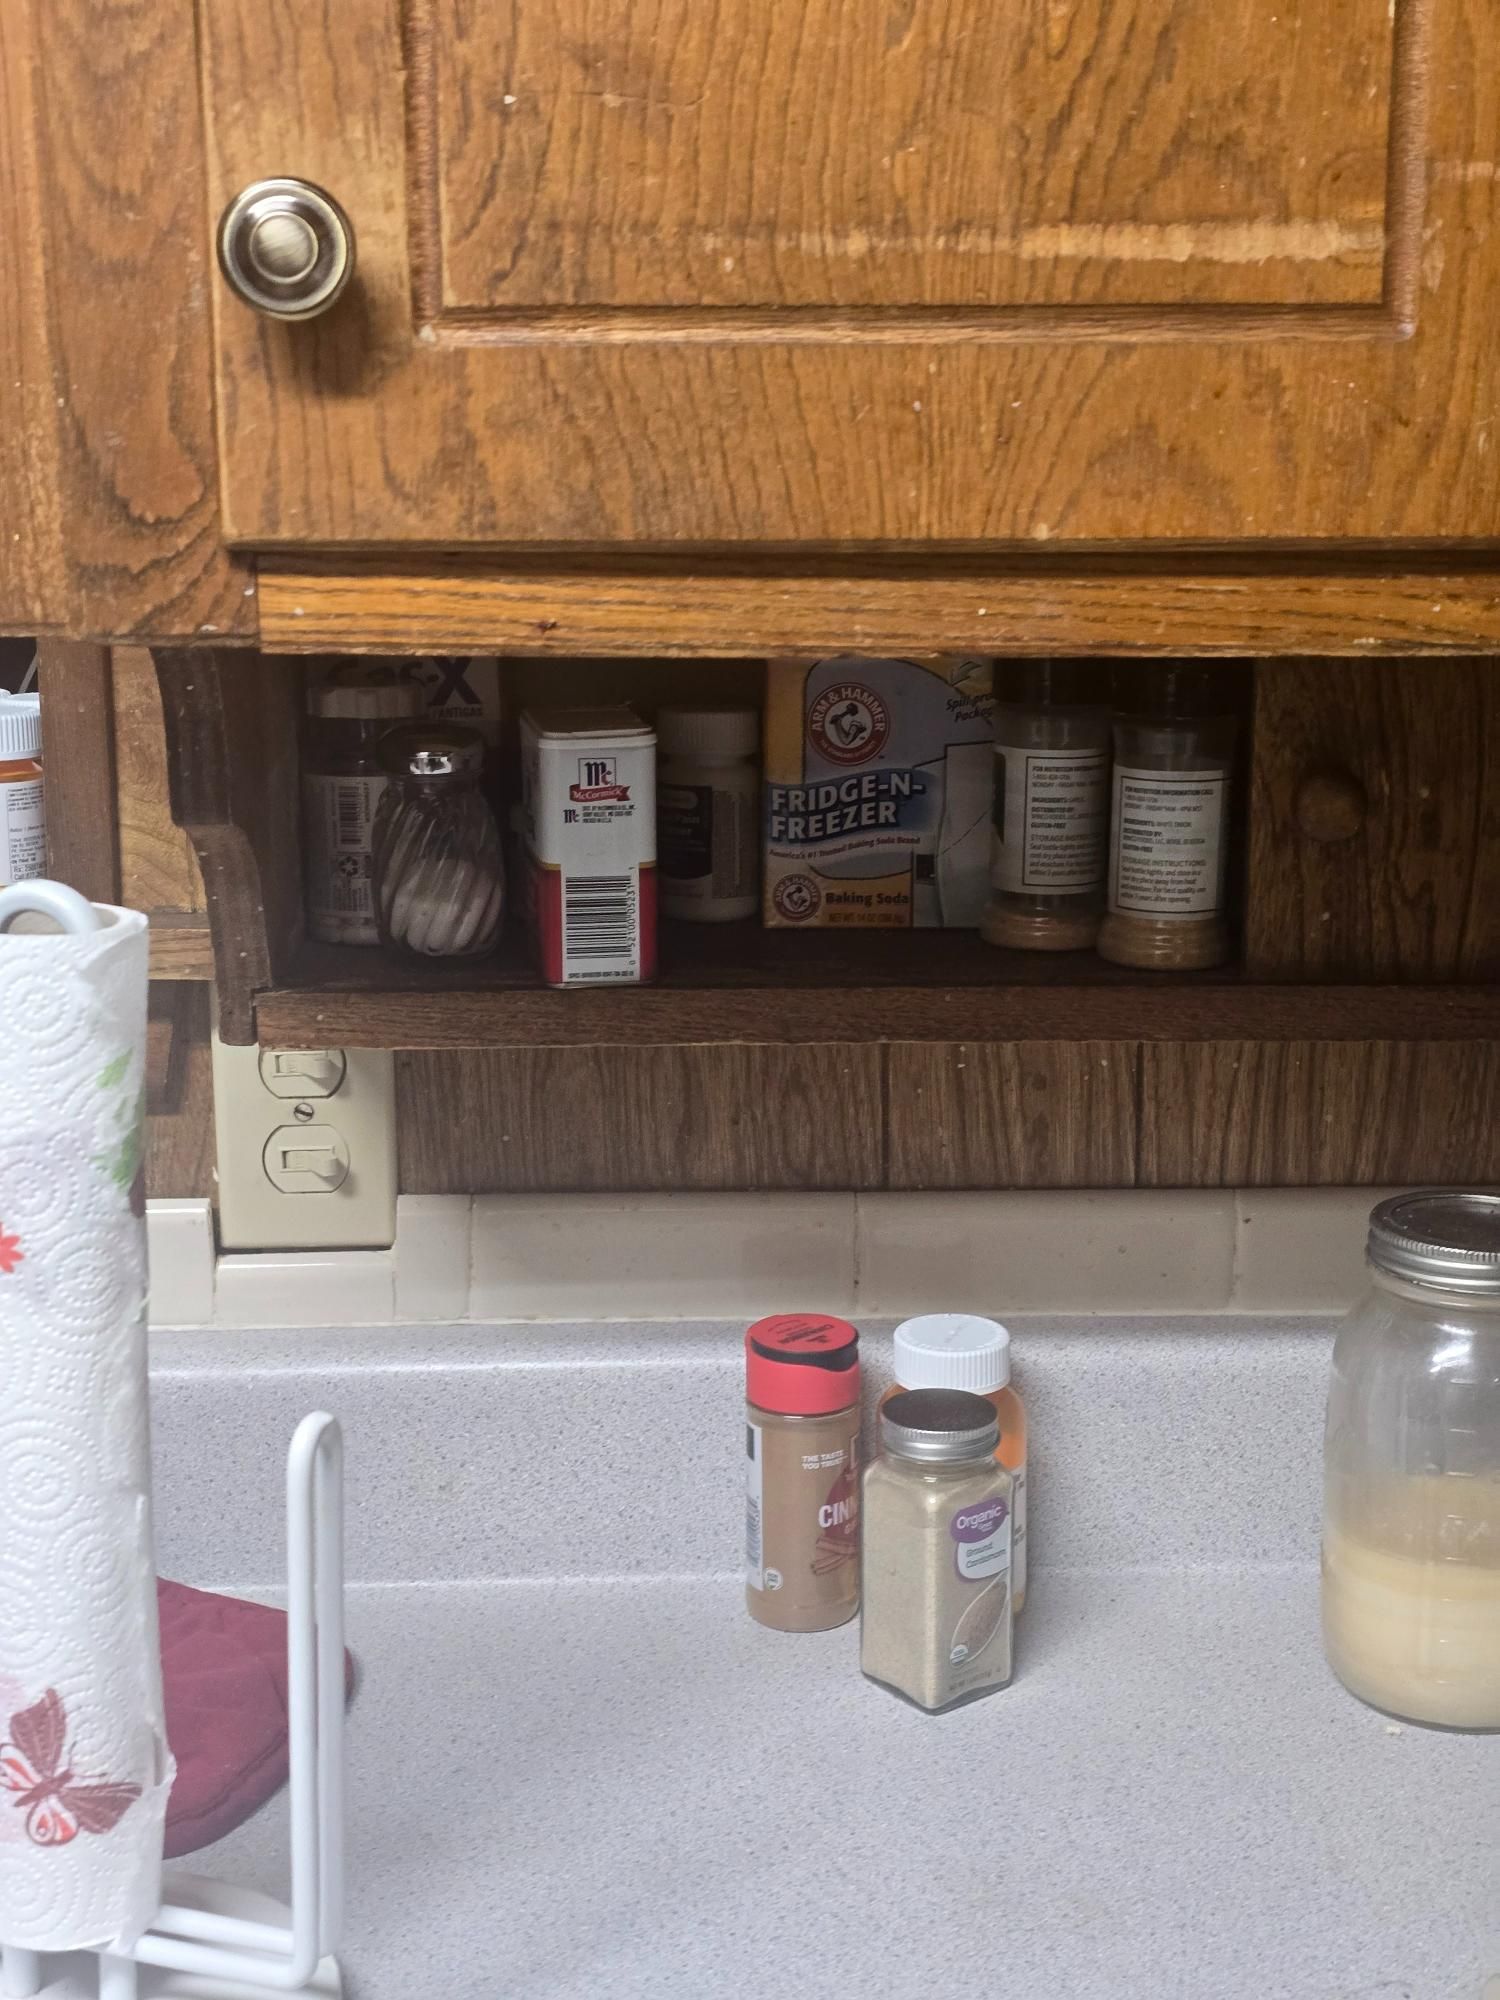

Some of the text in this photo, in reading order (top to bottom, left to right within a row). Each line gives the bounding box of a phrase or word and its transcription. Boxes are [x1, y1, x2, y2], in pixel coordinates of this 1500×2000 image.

[811, 686, 886, 732] ARM & HAMMER
[771, 772, 924, 813] FRIDGE-N-
[770, 800, 897, 841] FREEZER
[825, 891, 909, 908] Baking Soda
[802, 1450, 844, 1463] THE TASTE
[802, 1462, 820, 1471] YOU
[956, 1504, 1002, 1530] Organic
